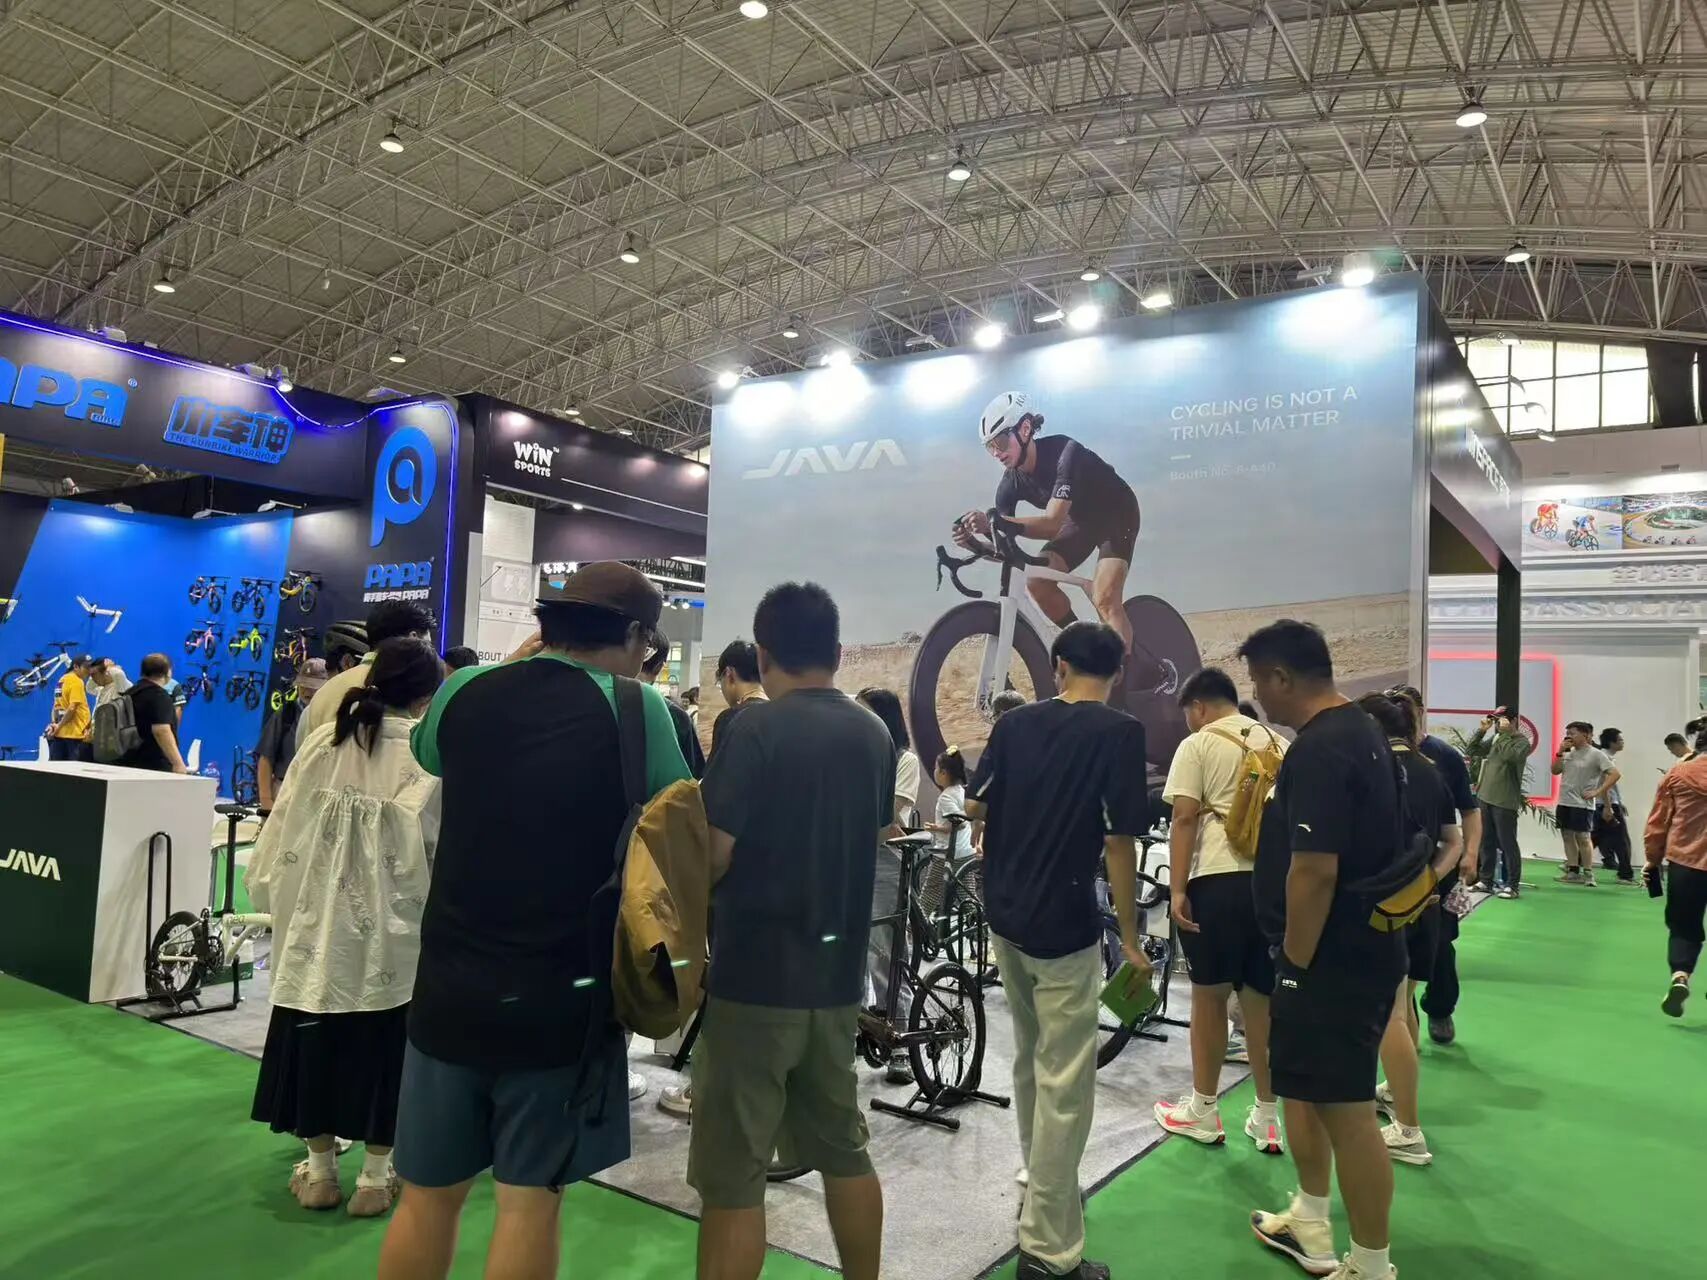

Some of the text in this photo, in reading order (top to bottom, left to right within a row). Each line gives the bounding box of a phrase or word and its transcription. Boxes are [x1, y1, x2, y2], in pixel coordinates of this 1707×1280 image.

[0, 356, 129, 428] PA
[1170, 385, 1358, 421] CYCLING IS NOT A
[1169, 409, 1340, 441] TRIVIAL MATTER
[170, 432, 190, 444] THE
[234, 447, 278, 462] WARRIOR
[742, 438, 908, 481] JAVA
[514, 459, 551, 478] SPORTS
[364, 561, 432, 589] PAPA
[478, 650, 502, 662] BOUT
[0, 848, 61, 881] JAVA
